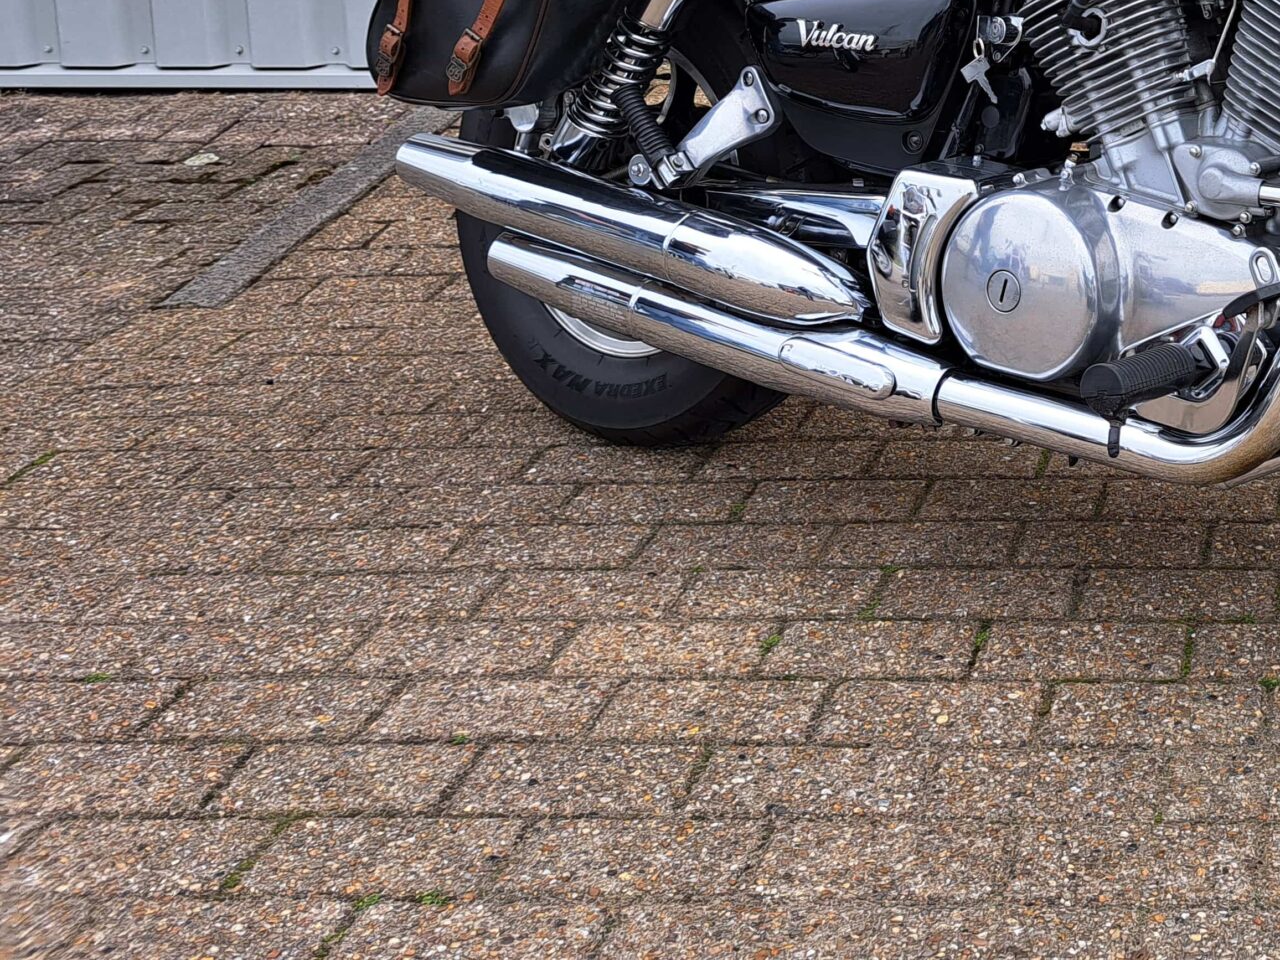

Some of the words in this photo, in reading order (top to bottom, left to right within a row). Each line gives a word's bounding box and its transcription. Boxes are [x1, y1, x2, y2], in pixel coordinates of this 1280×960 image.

[796, 18, 875, 51] Vulcan
[532, 348, 593, 394] MAX
[594, 372, 669, 400] EXEDRA
